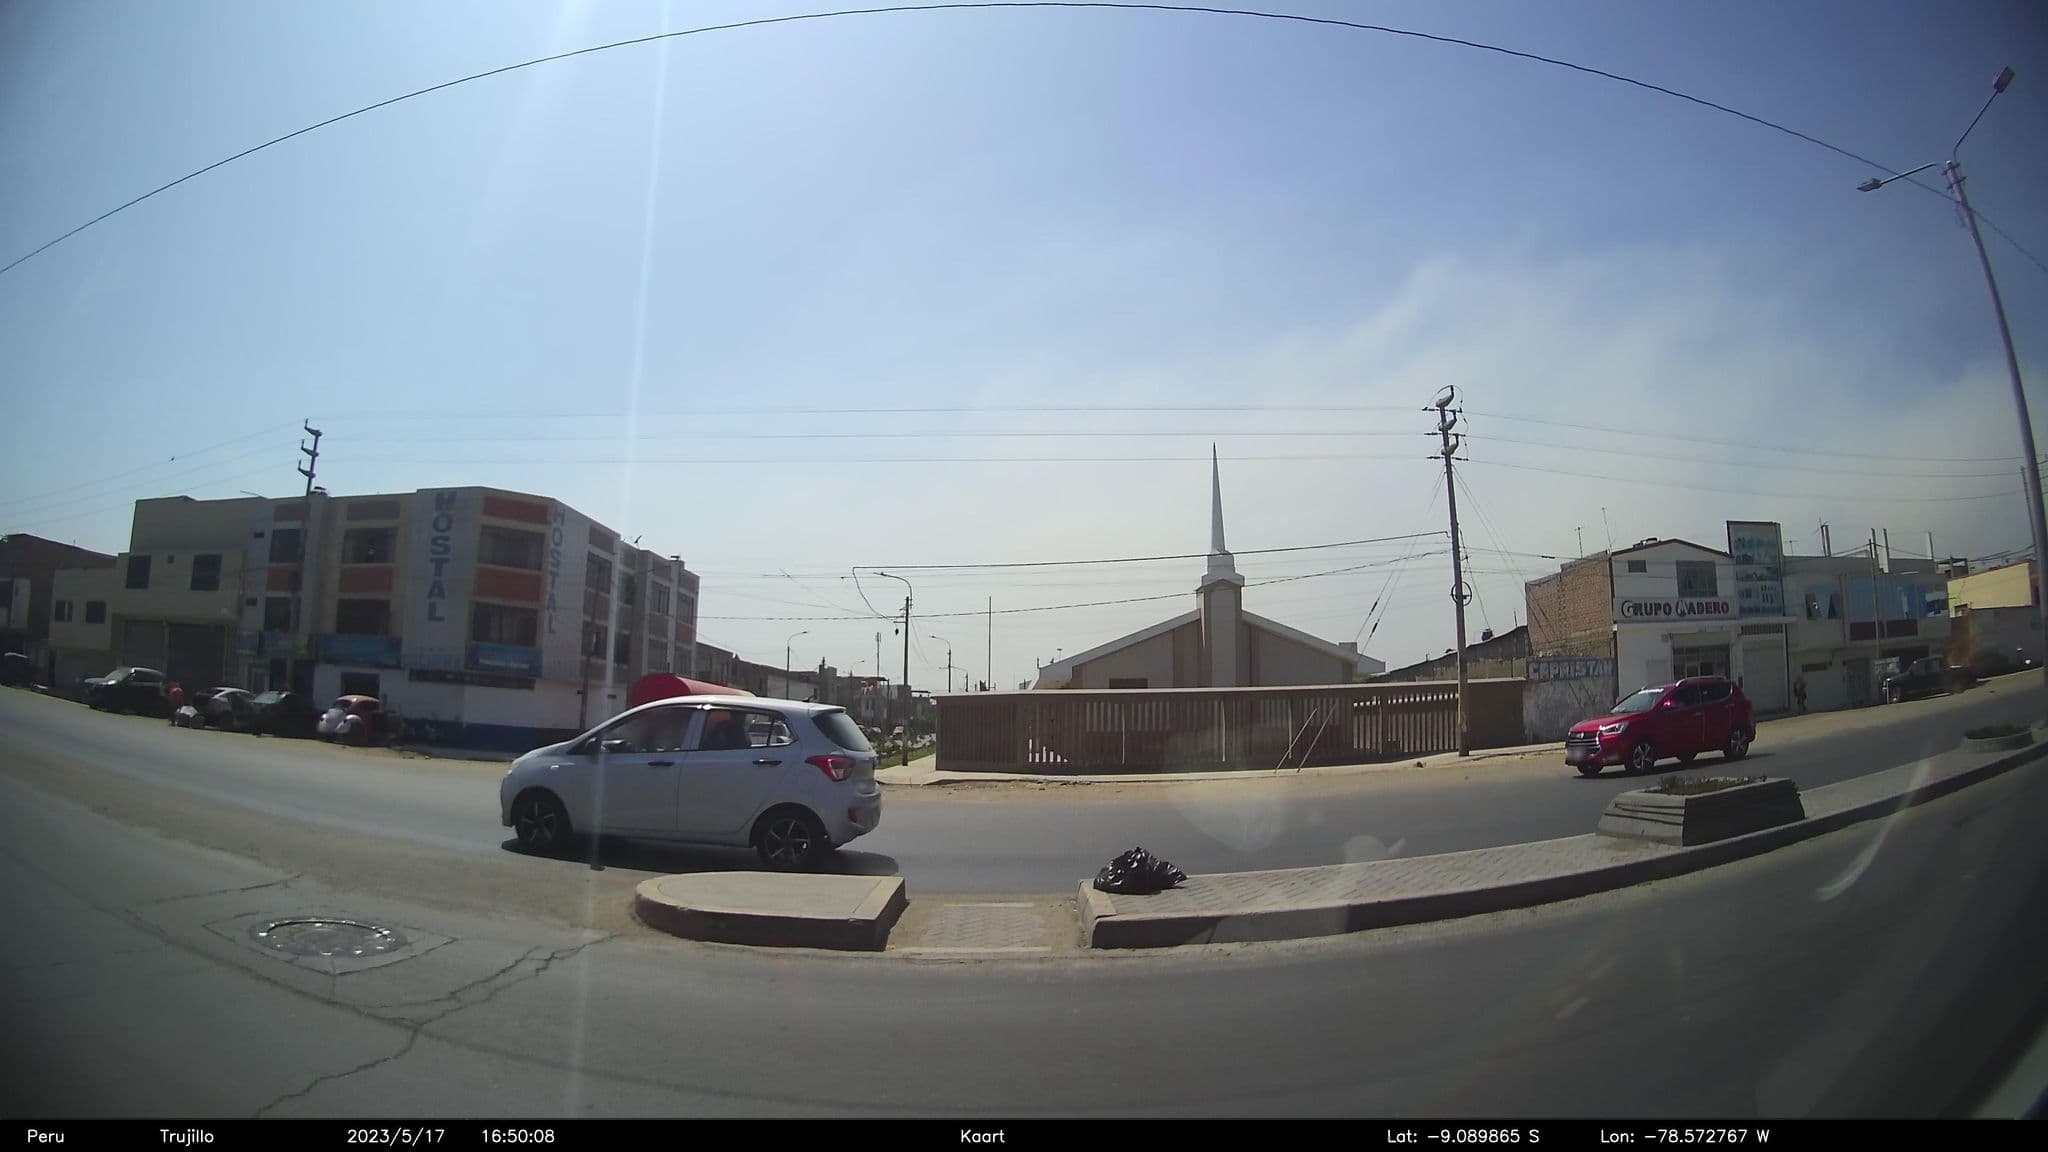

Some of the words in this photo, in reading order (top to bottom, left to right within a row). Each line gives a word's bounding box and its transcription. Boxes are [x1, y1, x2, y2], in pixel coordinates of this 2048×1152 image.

[427, 490, 457, 622] HOSTAL
[546, 506, 567, 635] HOSTAL
[1621, 600, 1672, 618] GRUPO
